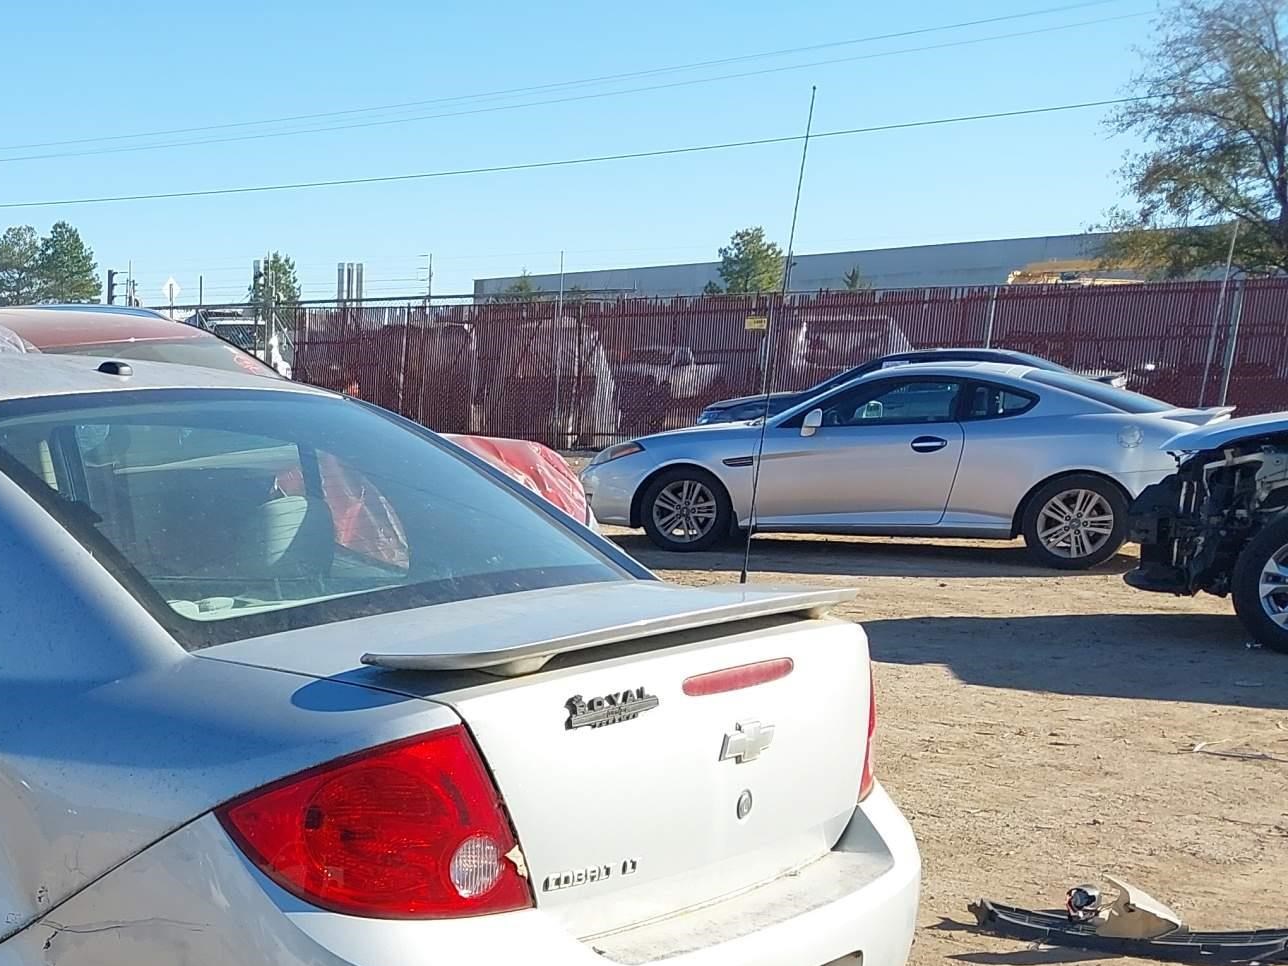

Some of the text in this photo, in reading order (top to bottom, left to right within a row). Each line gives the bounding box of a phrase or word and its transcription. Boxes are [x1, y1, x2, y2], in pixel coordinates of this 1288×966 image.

[569, 686, 651, 717] ROYAL
[542, 857, 642, 892] COBALT LT
